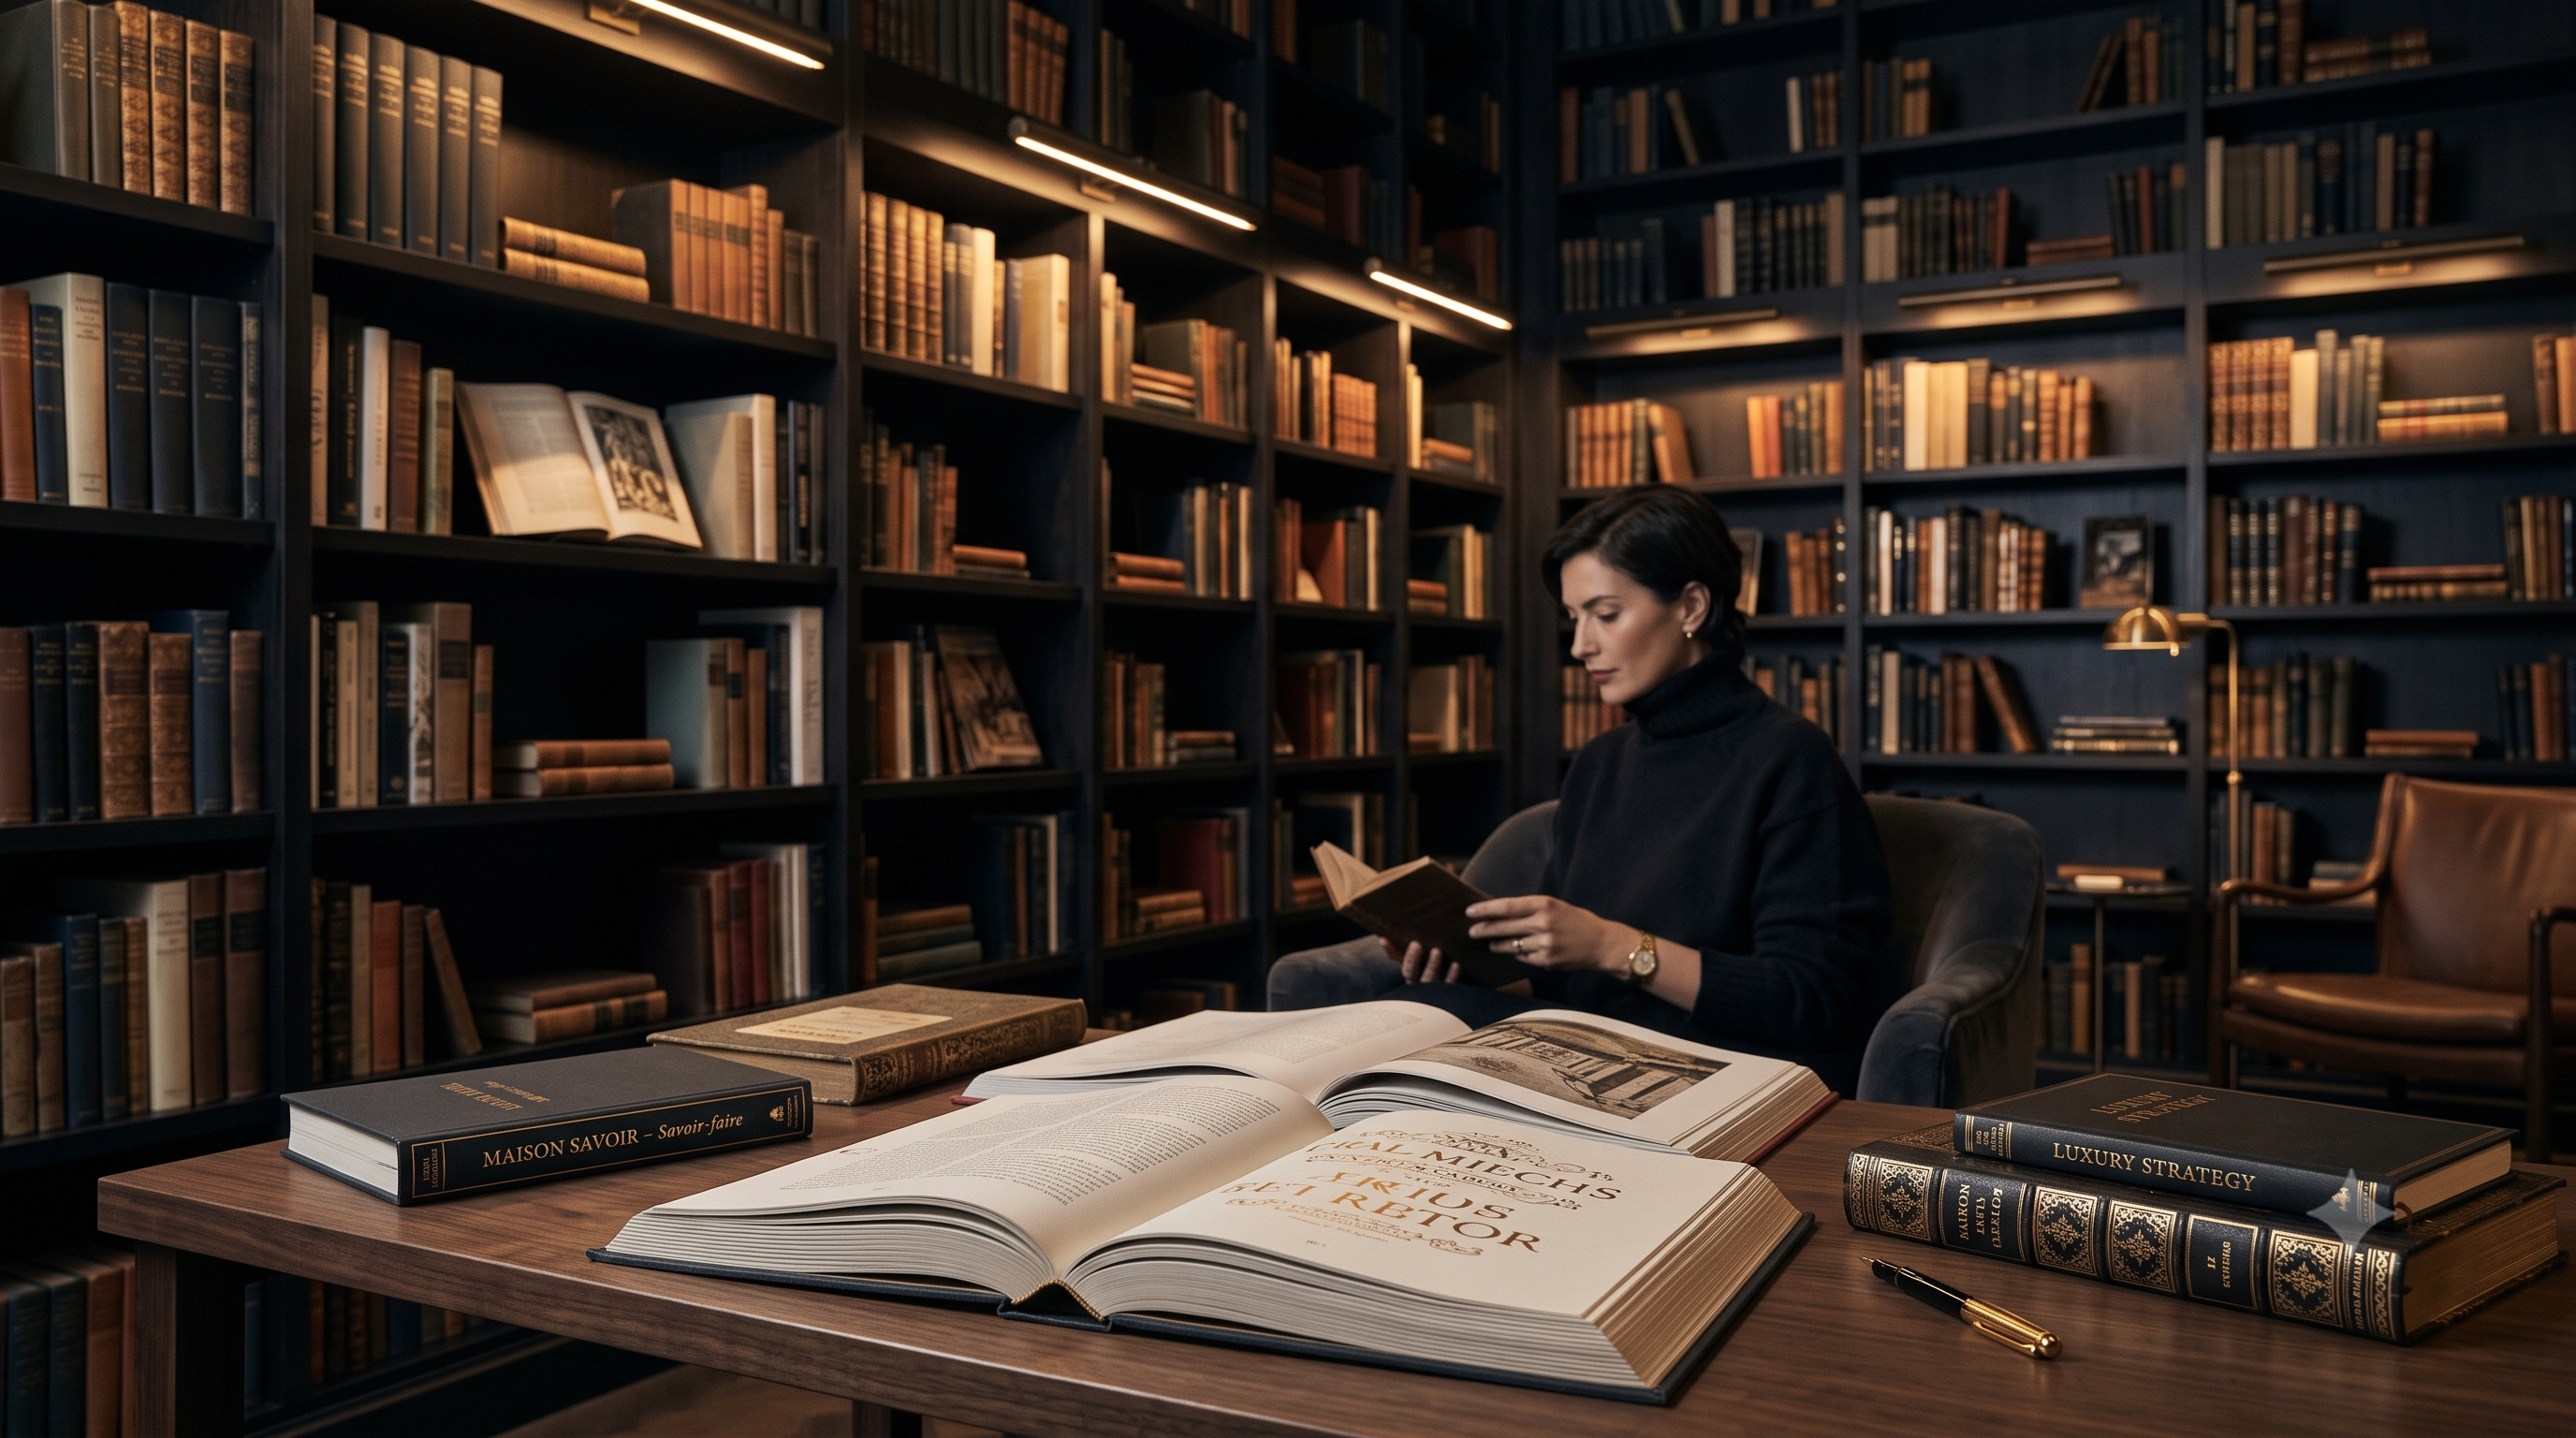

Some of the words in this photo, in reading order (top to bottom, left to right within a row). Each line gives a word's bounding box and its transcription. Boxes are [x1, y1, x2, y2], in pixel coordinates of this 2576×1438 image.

[483, 1139, 564, 1167] MAISON
[569, 1129, 639, 1153] SAVOIR
[658, 1115, 743, 1139] Savoir-faire
[1420, 1150, 1621, 1201] MIECHS
[2053, 1142, 2136, 1171] LUXURY
[2142, 1157, 2256, 1192] STRATEGY
[1329, 1191, 1541, 1254] RBTOR
